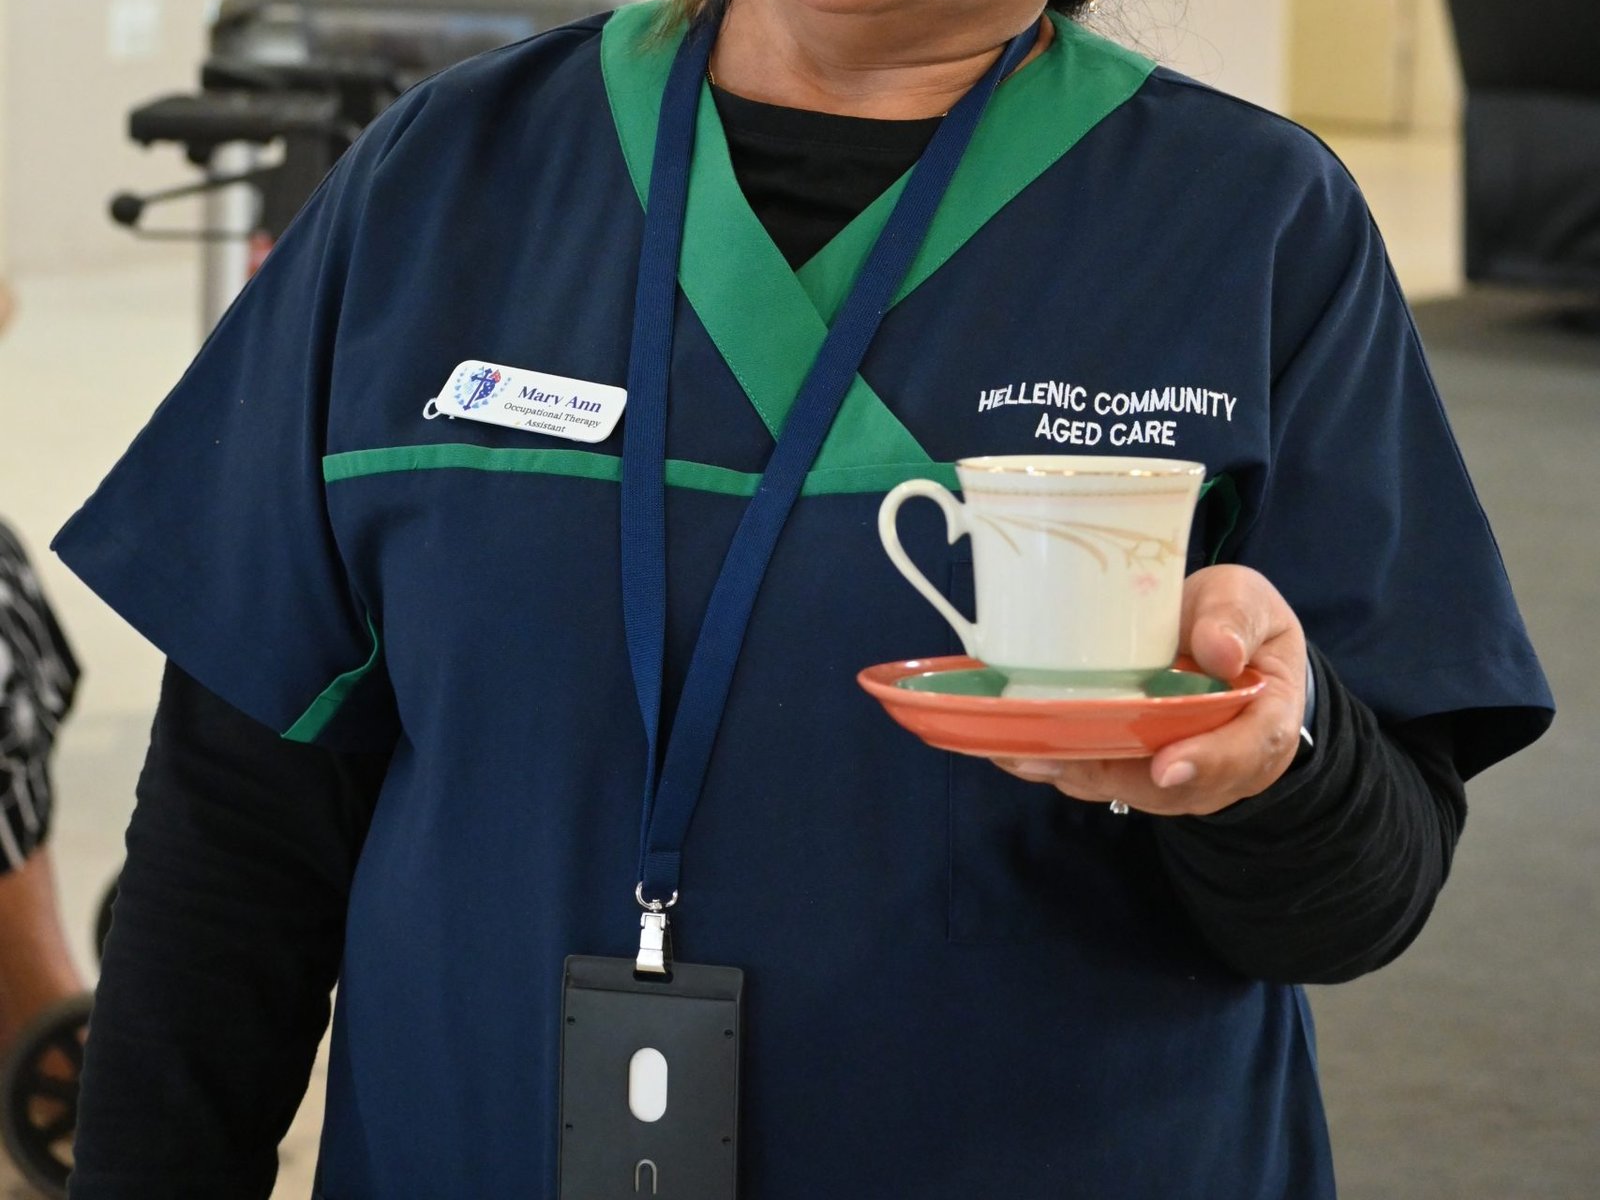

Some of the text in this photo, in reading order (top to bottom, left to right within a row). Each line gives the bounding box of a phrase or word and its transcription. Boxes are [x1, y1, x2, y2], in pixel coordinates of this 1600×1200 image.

[565, 396, 602, 413] Ann
[978, 380, 1237, 421] HELLENIC COMMUNITY
[503, 402, 601, 428] Occupational Therapy
[525, 419, 566, 433] Assistant
[1035, 413, 1177, 447] AGED CARE
